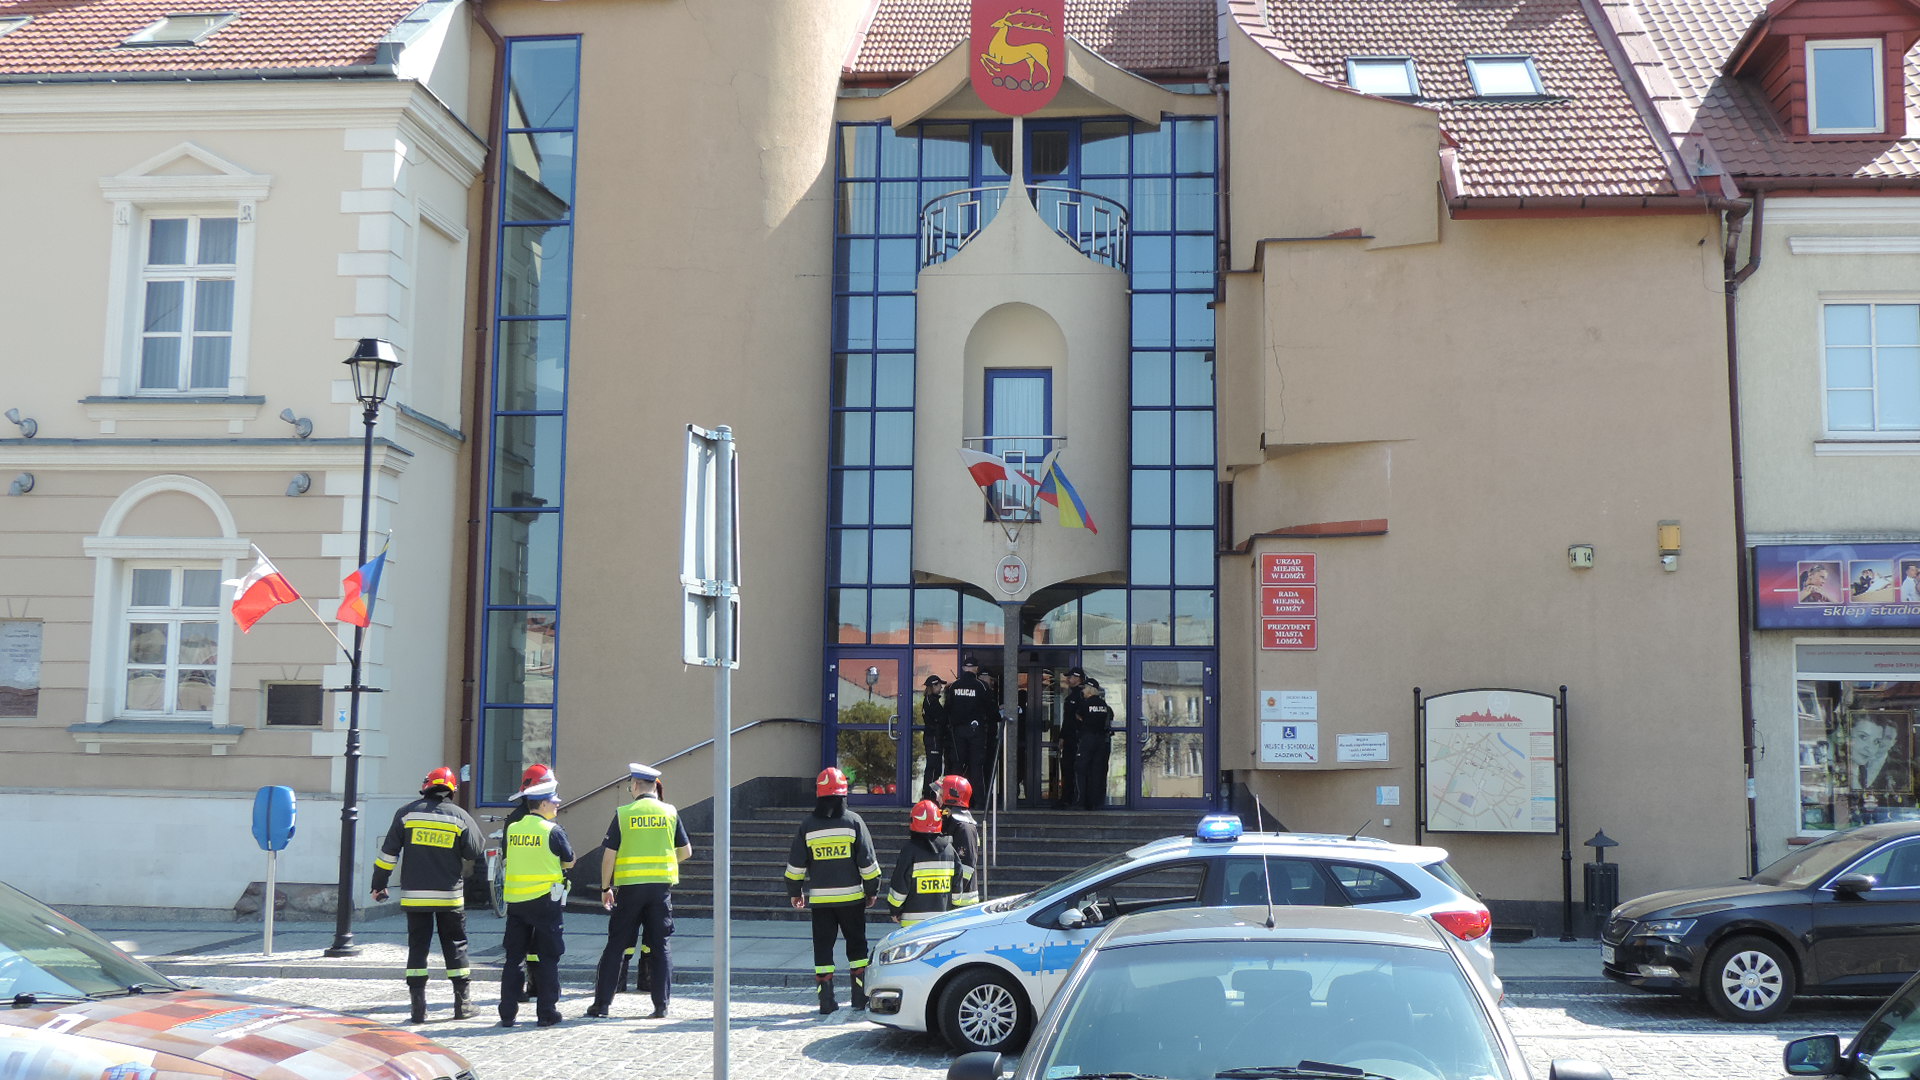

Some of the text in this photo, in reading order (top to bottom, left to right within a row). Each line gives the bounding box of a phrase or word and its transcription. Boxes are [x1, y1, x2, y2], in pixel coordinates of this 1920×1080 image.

[1570, 552, 1577, 563] 14
[1583, 552, 1591, 563] 14
[1823, 605, 1920, 617] sklep studio
[954, 688, 976, 697] POLICJA
[631, 816, 668, 828] POLICJA
[509, 834, 541, 847] POLICJA
